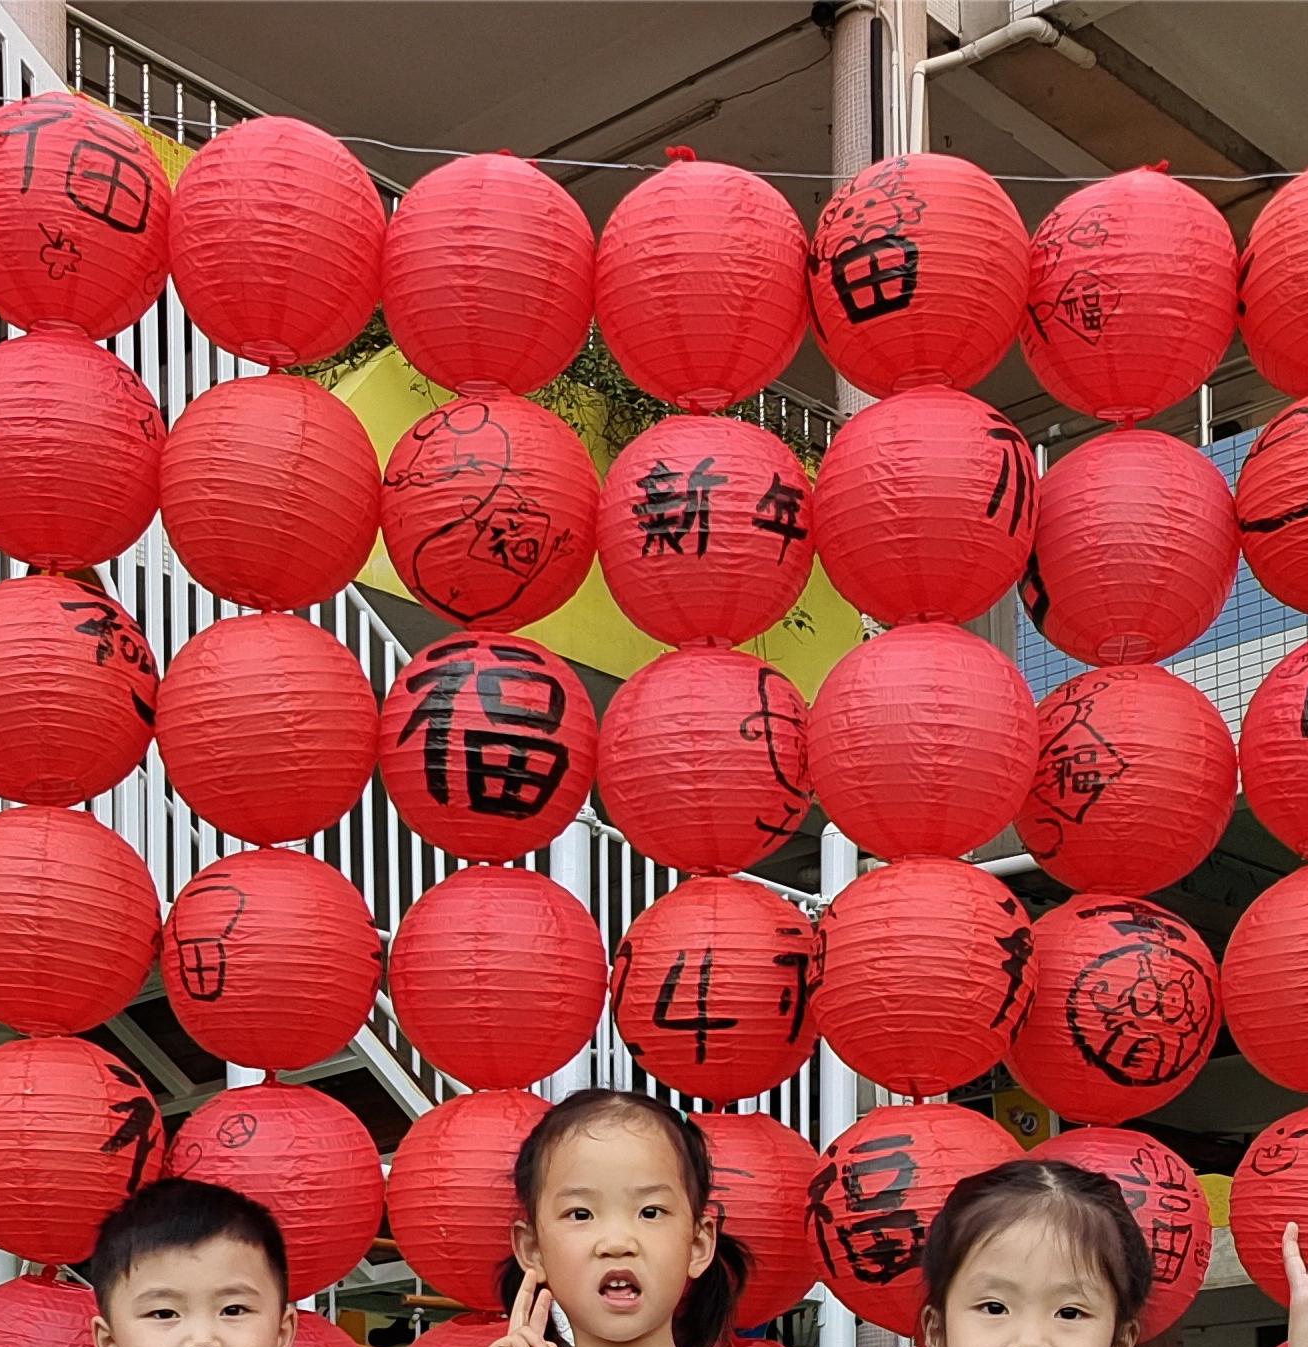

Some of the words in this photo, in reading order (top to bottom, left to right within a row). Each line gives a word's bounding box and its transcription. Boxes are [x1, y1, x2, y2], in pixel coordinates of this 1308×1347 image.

[630, 456, 810, 566] 新年
[398, 640, 570, 820] 福
[804, 1133, 925, 1285] 福
